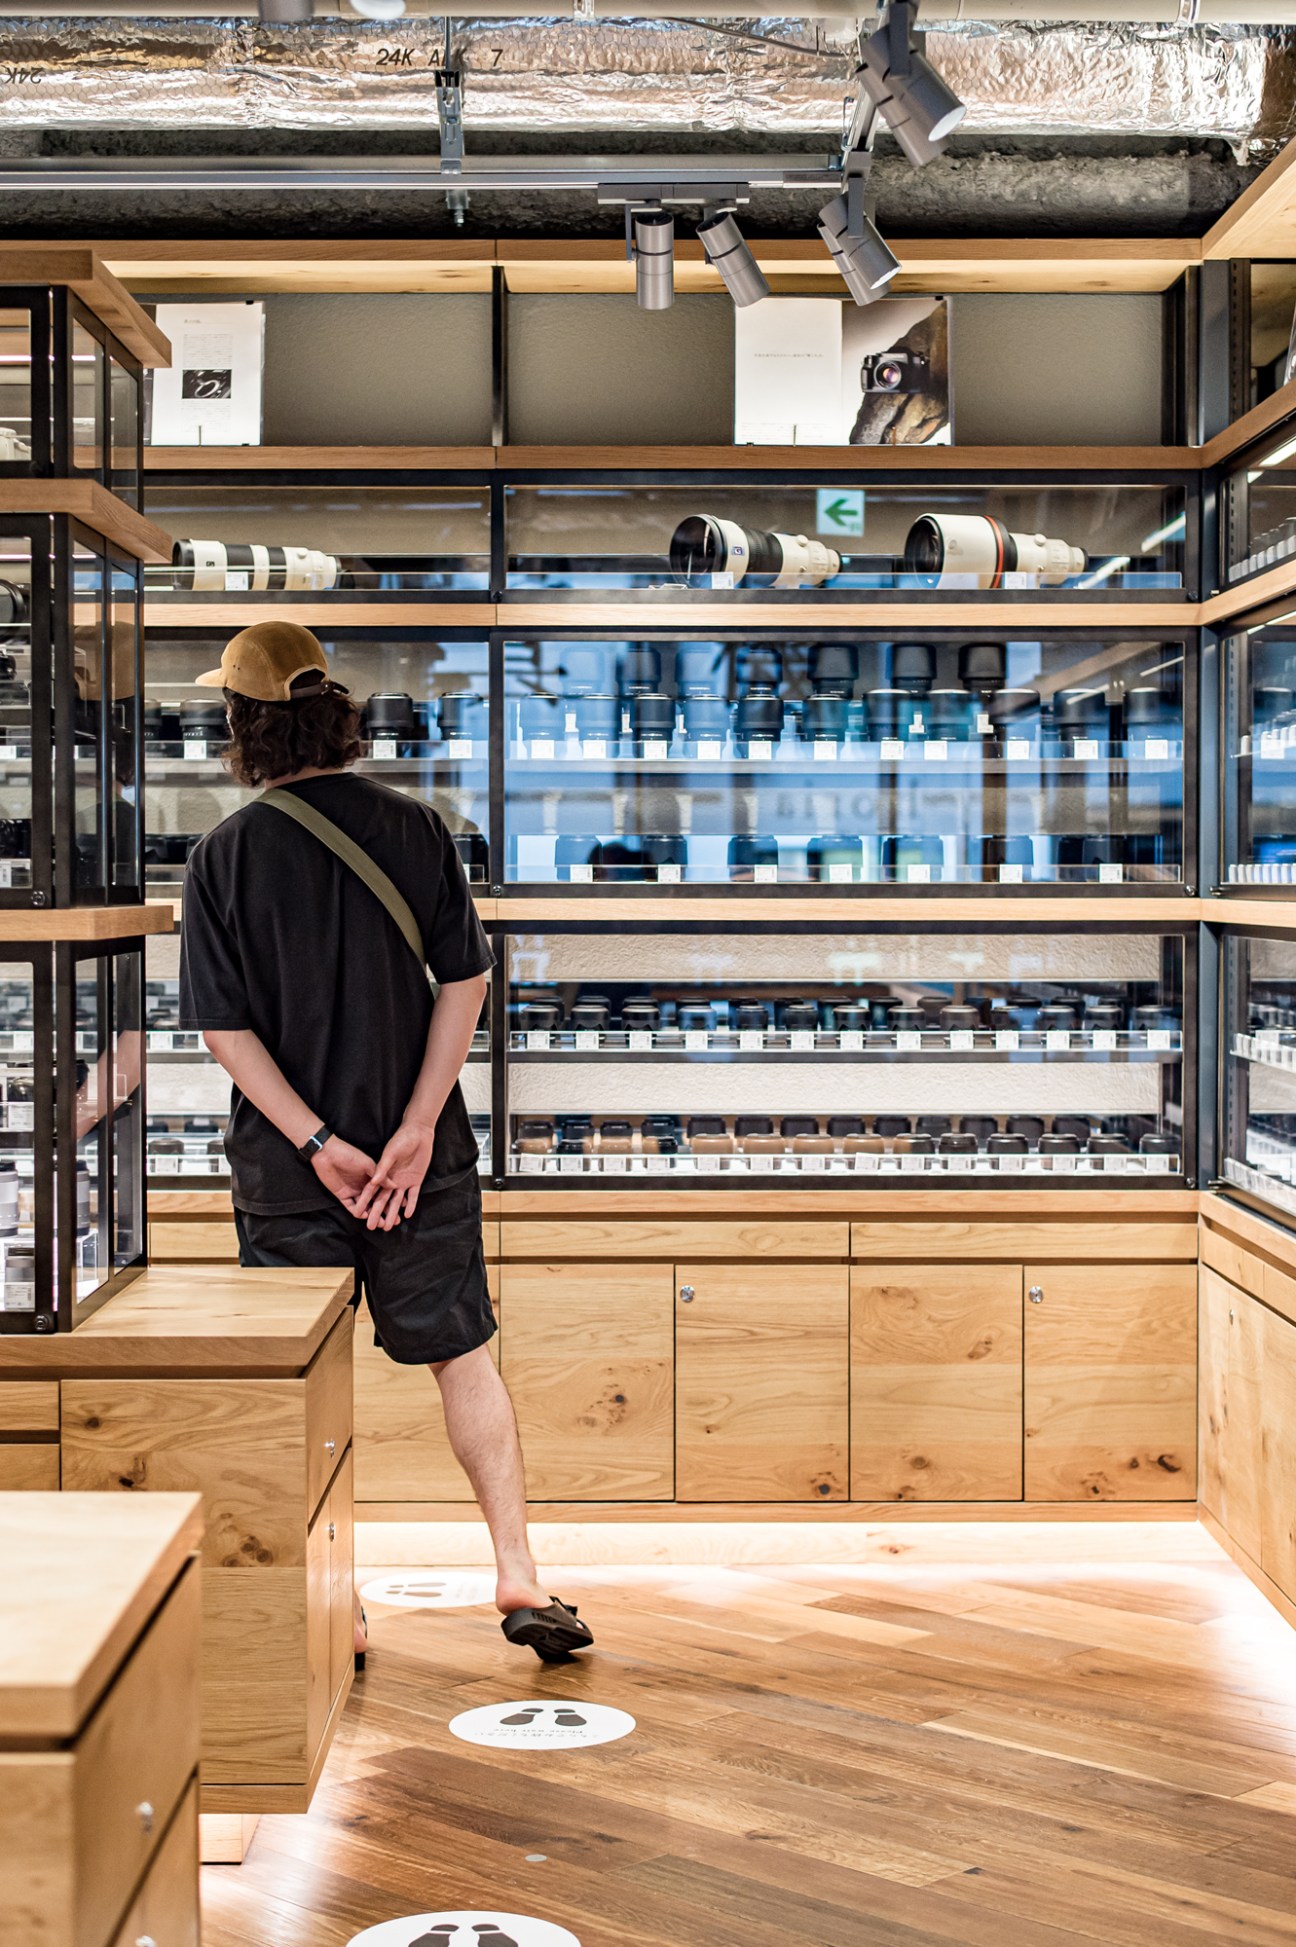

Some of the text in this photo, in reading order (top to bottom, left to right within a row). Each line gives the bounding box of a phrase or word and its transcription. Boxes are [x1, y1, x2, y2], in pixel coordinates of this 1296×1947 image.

[376, 48, 415, 66] 24K
[491, 49, 503, 66] 7
[3, 66, 43, 84] 24K
